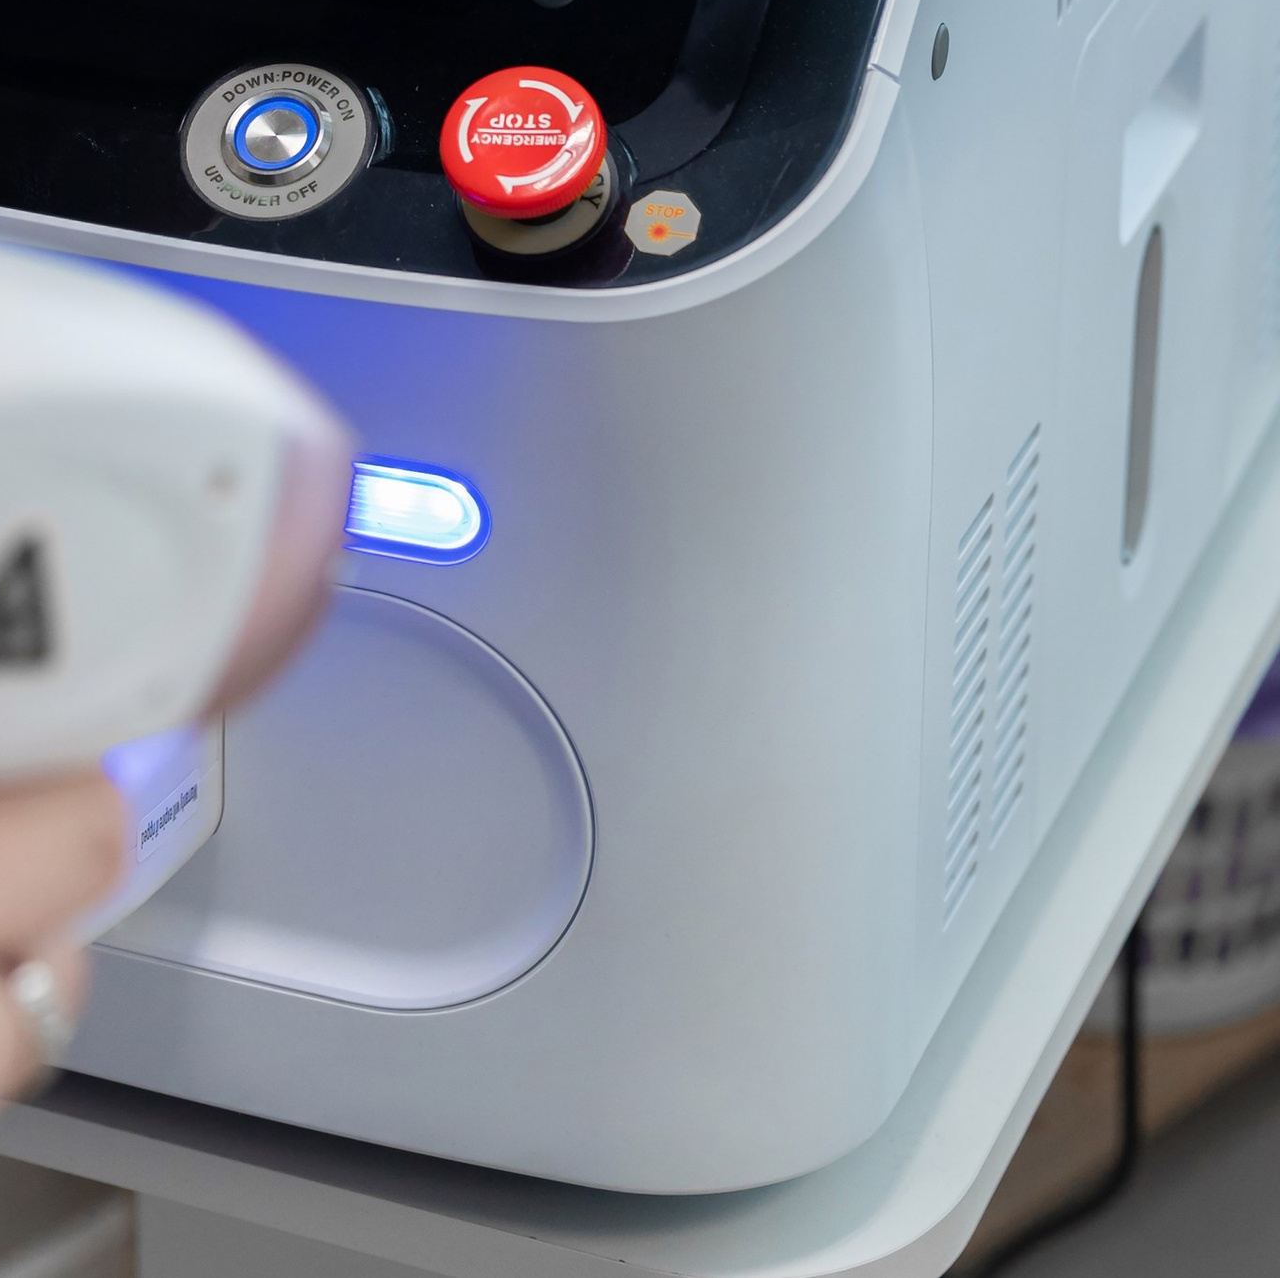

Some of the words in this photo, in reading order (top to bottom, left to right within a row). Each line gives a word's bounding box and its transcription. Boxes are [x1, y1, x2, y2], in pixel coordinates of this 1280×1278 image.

[336, 99, 356, 122] ON
[489, 113, 552, 129] STOP
[470, 133, 568, 146] EMERGENCY
[286, 180, 319, 204] OFF
[644, 203, 686, 219] STOP
